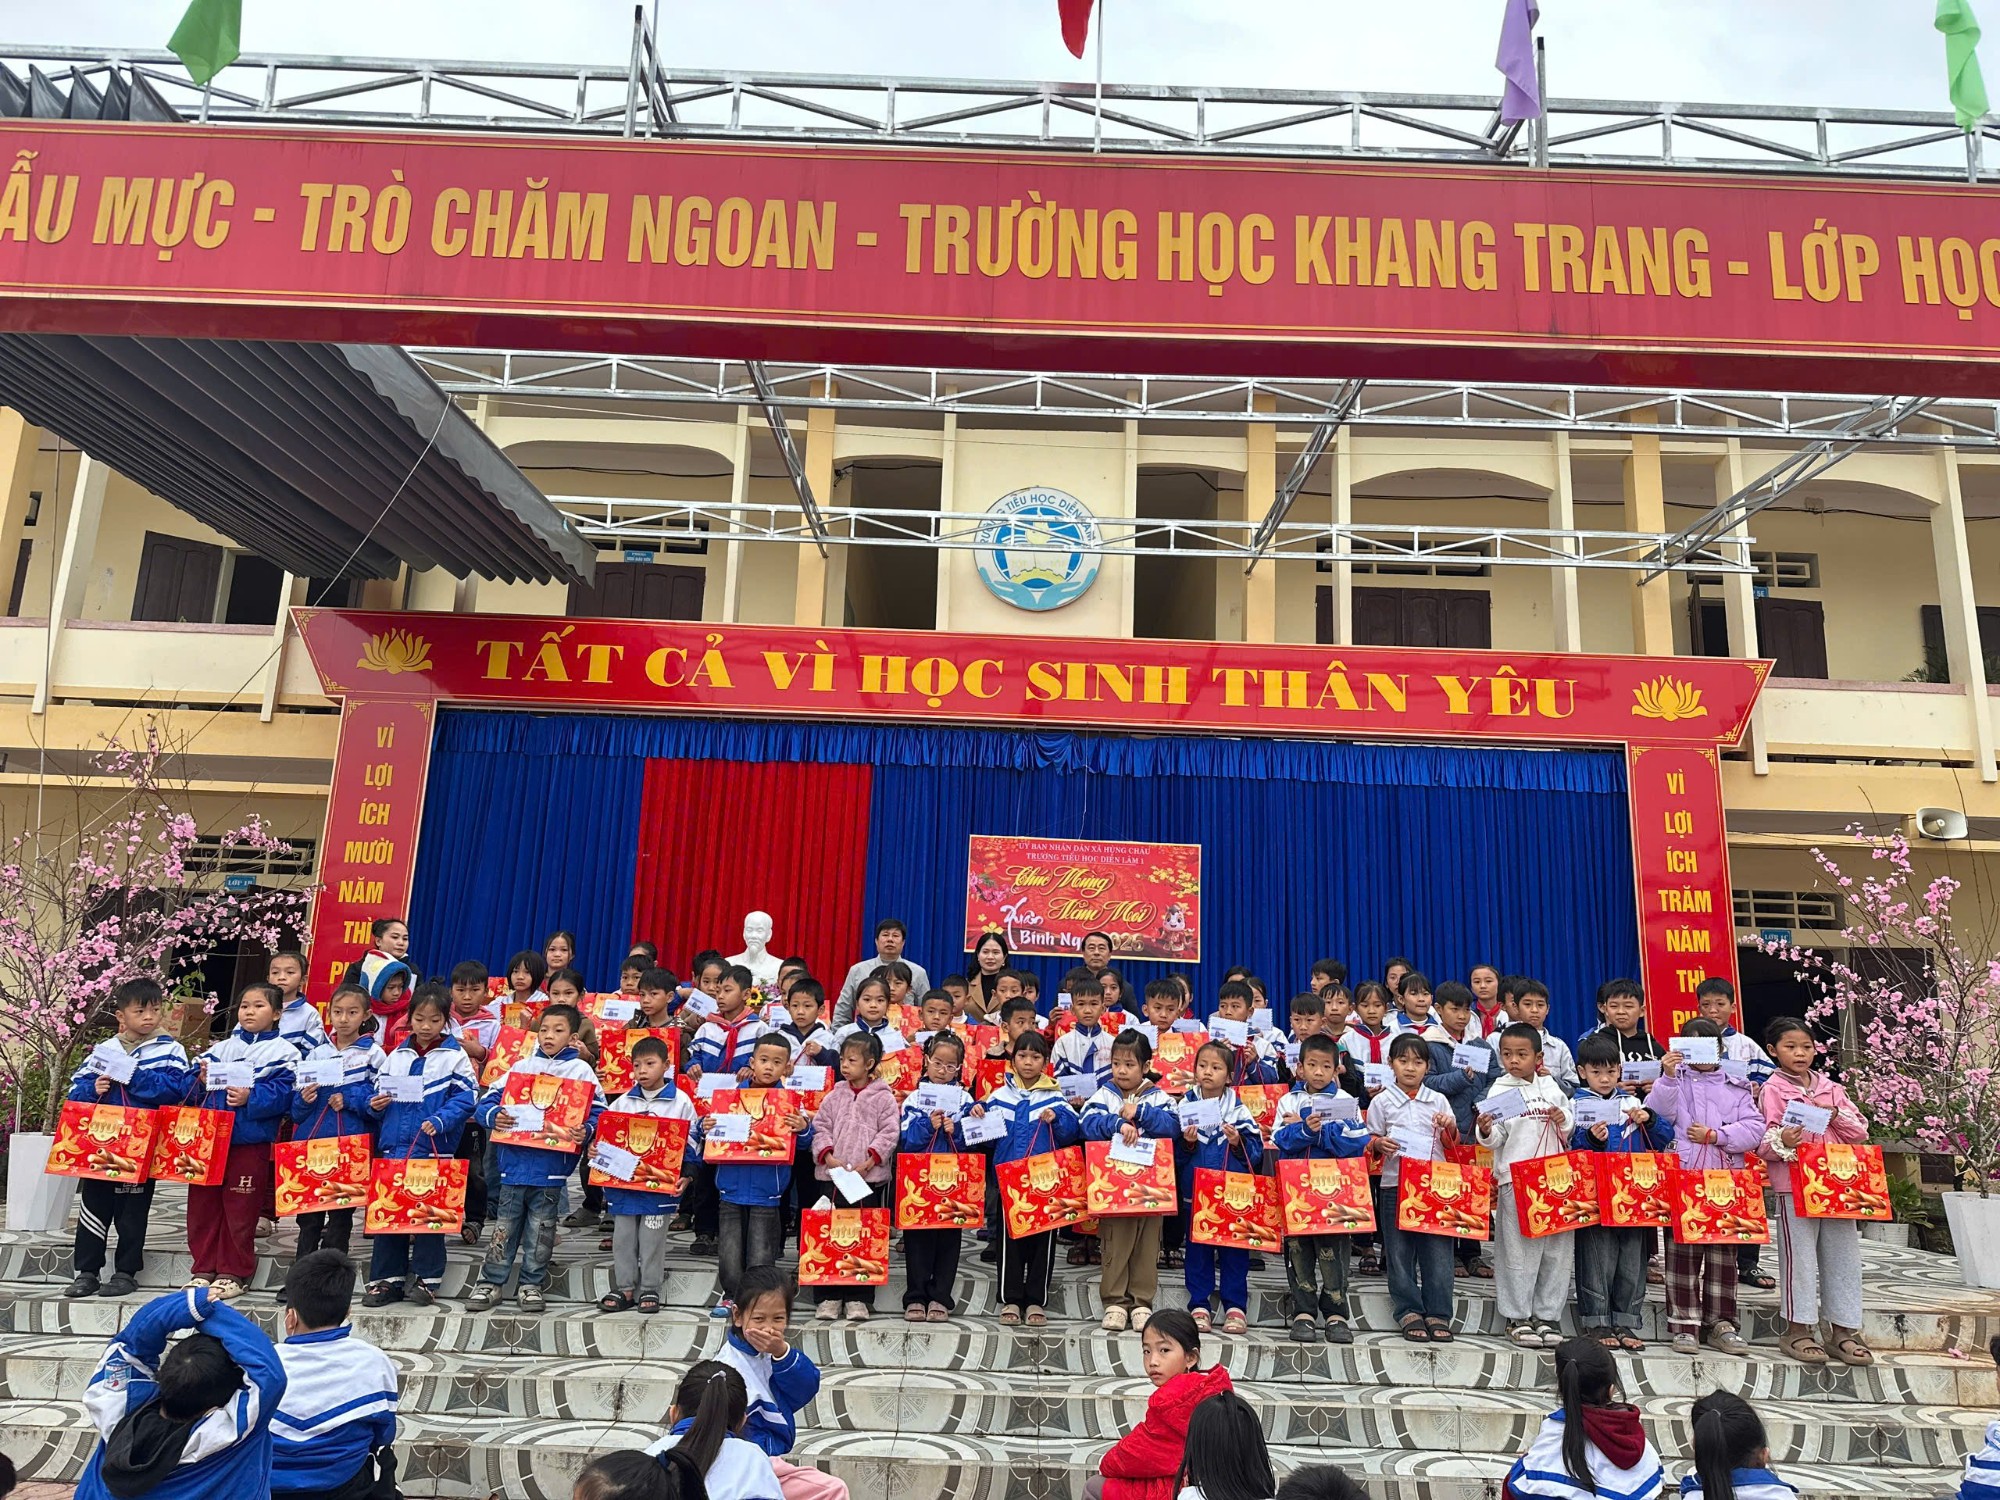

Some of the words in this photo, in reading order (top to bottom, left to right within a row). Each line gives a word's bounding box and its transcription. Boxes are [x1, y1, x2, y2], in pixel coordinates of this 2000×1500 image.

[94, 172, 234, 261] MỰC
[301, 169, 411, 253] TRÒ
[432, 177, 608, 261] CHĂM
[629, 196, 836, 270] NGOAN
[901, 191, 1137, 281] TRƯỜNG
[1158, 211, 1274, 297] HỌC
[1296, 216, 1497, 291] KHANG
[1515, 223, 1711, 298] TRANG
[1769, 218, 1879, 302] LỚP
[1006, 494, 1027, 511] TIỂU
[1030, 494, 1056, 505] HỌC
[1059, 499, 1083, 519] DIỄN
[478, 625, 623, 684] TẤT
[645, 633, 734, 688] CẢ
[763, 640, 834, 692] VÌ
[861, 655, 1004, 708] HỌC
[1026, 662, 1188, 704] SINH
[1212, 660, 1408, 713] THÂN
[1435, 665, 1575, 718] YÊU
[376, 722, 395, 748] VÌ
[364, 764, 394, 791] LỢI
[1666, 768, 1685, 795] VÌ
[358, 798, 391, 825] ÍCH
[1664, 810, 1693, 839] LỢI
[344, 838, 394, 865] MƯỜI
[1026, 851, 1059, 861] TRƯỜNG
[1061, 851, 1080, 862] TIỂU
[1082, 855, 1098, 863] HỌC
[1100, 854, 1120, 863] DIỄN
[1122, 856, 1138, 864] LÂM
[1049, 843, 1071, 851] NHÂN
[1073, 844, 1090, 852] DÂN
[1667, 846, 1698, 874] ÍCH
[338, 876, 384, 904] NĂM
[1006, 866, 1052, 894] Chúc
[1048, 866, 1115, 898] Mừng
[1658, 886, 1712, 913] TRĂM
[343, 915, 373, 945] THÌ
[1000, 897, 1044, 950] Xuân
[1020, 929, 1055, 946] Bính
[1060, 931, 1082, 950] Ng
[1104, 931, 1145, 951] 026
[1666, 924, 1711, 953] NĂM
[78, 1117, 133, 1136] Saturn
[168, 1120, 204, 1137] Saturn
[295, 1151, 350, 1168] Saturn
[1818, 1156, 1868, 1172] Saturn
[238, 1176, 253, 1187] H
[393, 1172, 448, 1187] Saturn
[919, 1168, 968, 1183] Saturn
[1020, 1167, 1069, 1188] Saturn
[1300, 1172, 1351, 1188] Saturn
[1420, 1174, 1472, 1193] Saturn
[1538, 1170, 1582, 1189] Saturn
[1624, 1166, 1666, 1181] Saturn
[1214, 1185, 1264, 1205] Saturn
[1695, 1183, 1746, 1198] Saturn
[820, 1224, 871, 1239] Saturn
